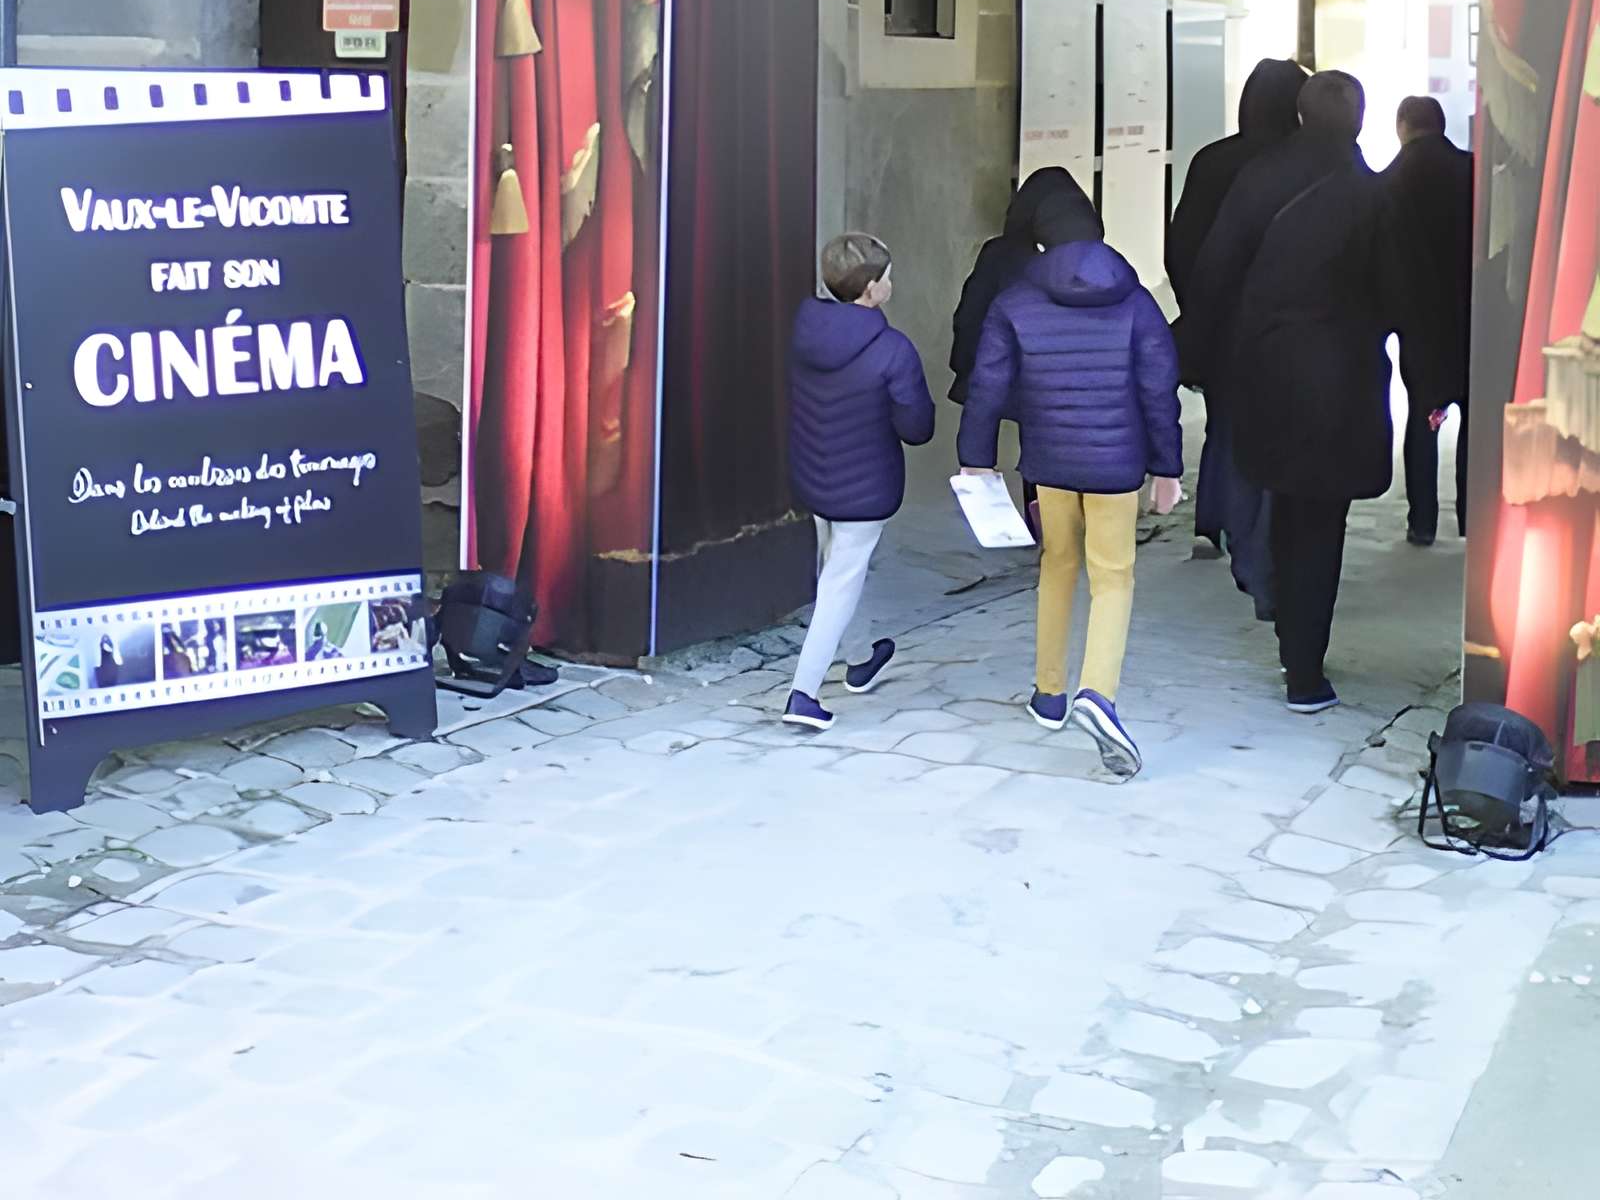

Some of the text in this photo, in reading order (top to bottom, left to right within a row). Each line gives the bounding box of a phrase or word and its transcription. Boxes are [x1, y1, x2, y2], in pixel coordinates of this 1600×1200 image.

[151, 259, 280, 292] FAIT SON
[74, 308, 364, 407] CINÉMA
